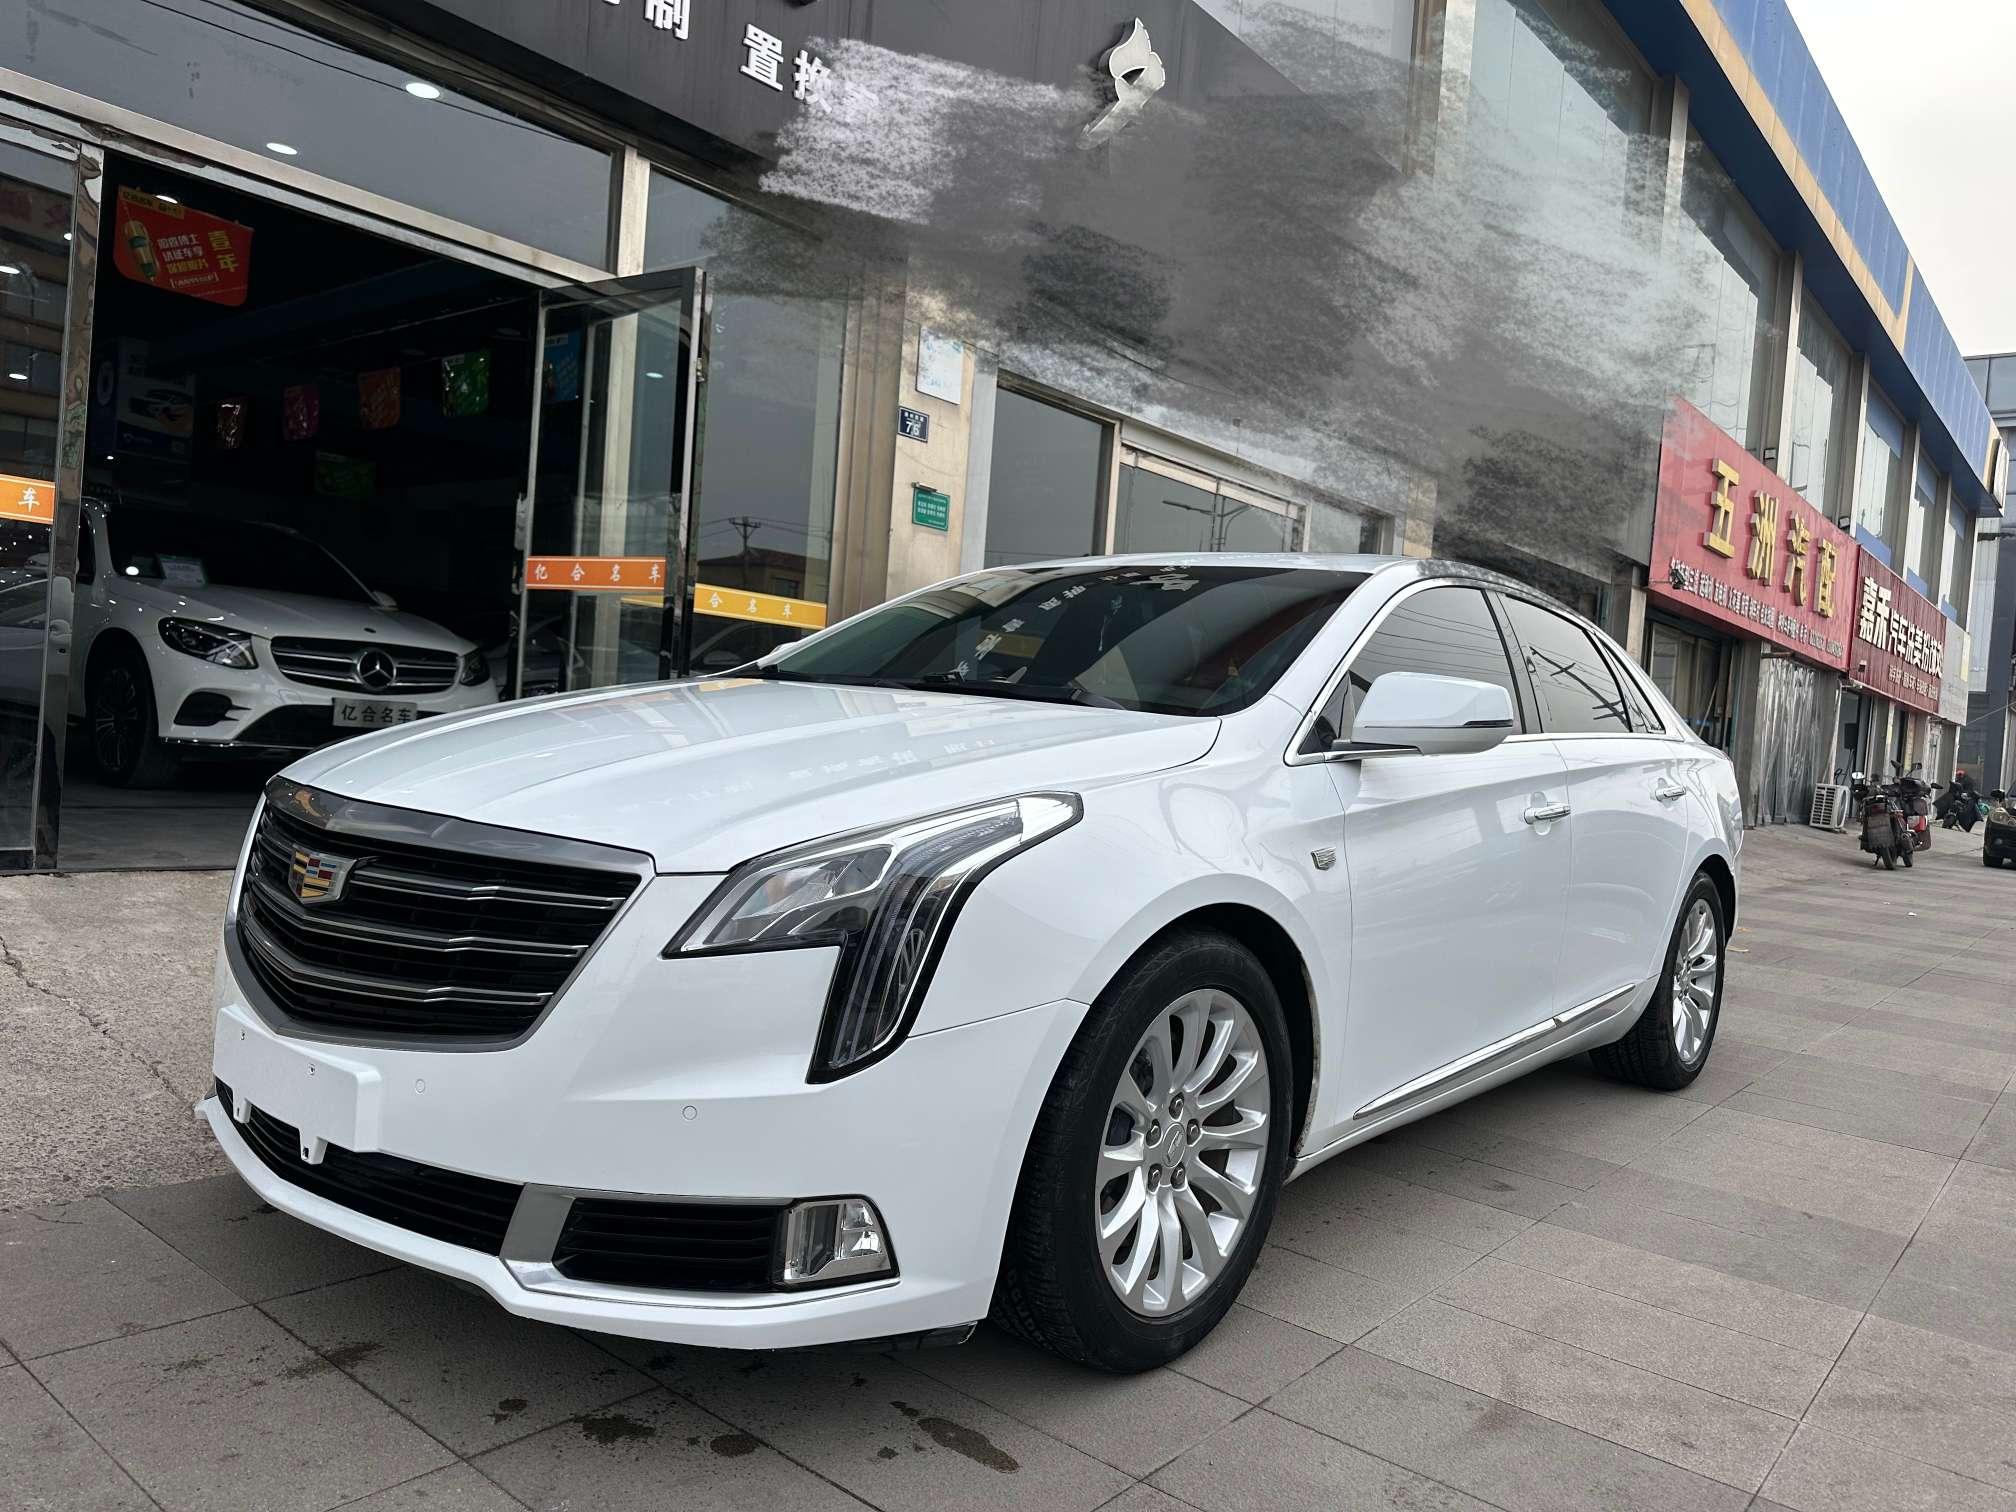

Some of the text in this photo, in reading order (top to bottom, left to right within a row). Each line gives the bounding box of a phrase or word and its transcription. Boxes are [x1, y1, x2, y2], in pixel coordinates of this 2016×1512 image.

[18, 487, 41, 513] 车
[1703, 458, 1837, 618] 五洲汽配
[534, 563, 661, 584] 亿合名车
[710, 592, 793, 618] 合名车
[341, 704, 412, 723] 亿合名车
